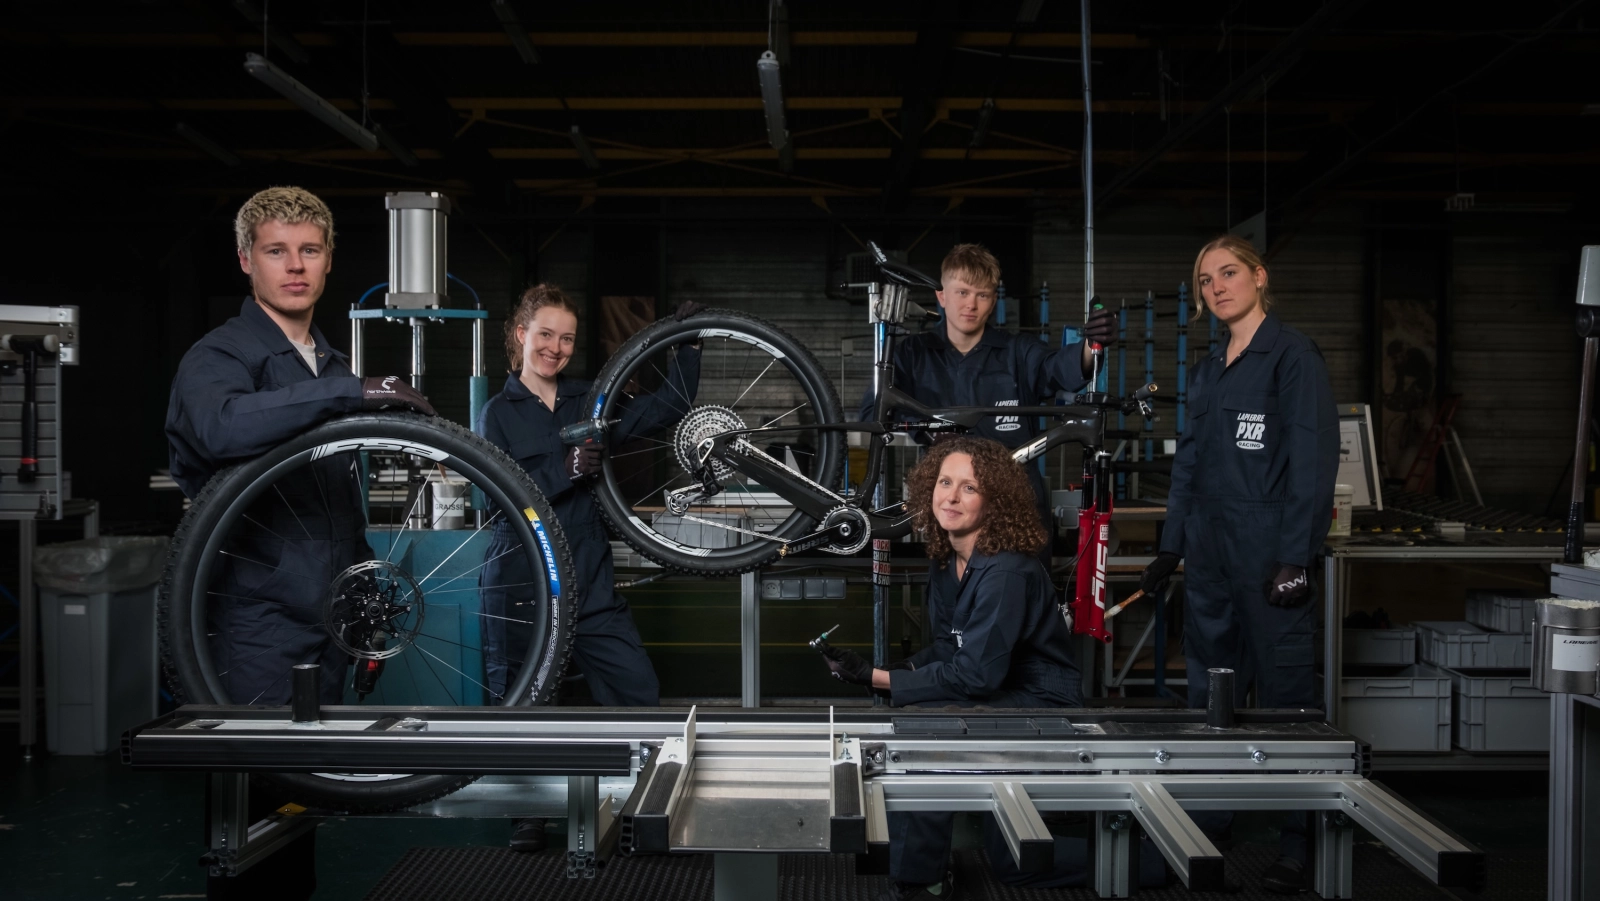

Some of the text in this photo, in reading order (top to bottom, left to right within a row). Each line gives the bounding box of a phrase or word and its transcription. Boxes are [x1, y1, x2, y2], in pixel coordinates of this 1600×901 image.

[1237, 412, 1265, 422] LAPIERRE
[1235, 421, 1266, 441] PXR
[434, 503, 464, 511] GRAISSE
[537, 529, 558, 582] MICHELIN
